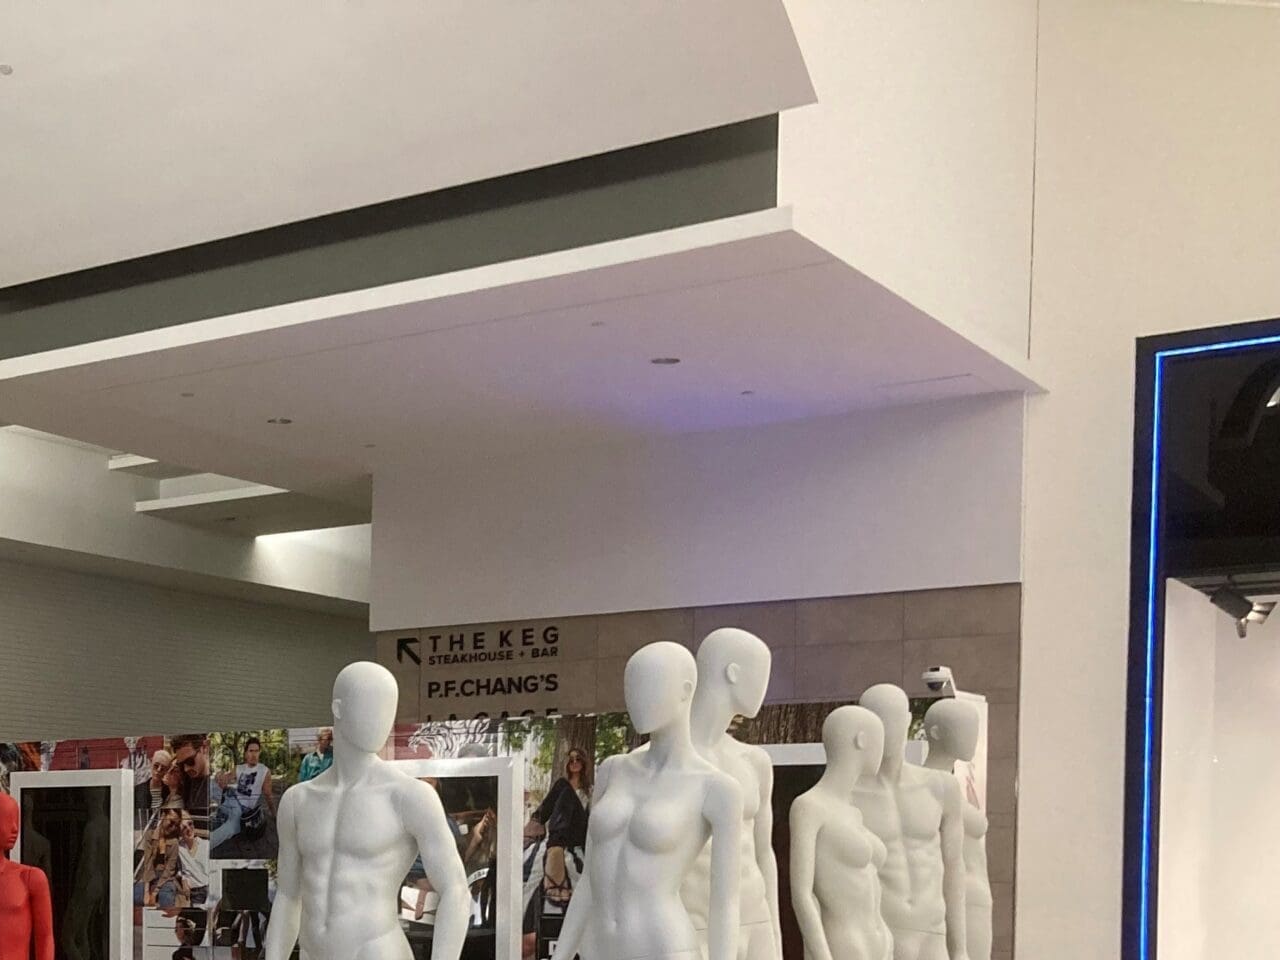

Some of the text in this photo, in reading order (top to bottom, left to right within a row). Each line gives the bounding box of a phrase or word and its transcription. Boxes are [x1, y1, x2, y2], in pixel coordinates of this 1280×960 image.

[428, 626, 559, 652] THE KEG
[428, 650, 514, 666] STEAKHOUSE
[531, 646, 558, 658] BAR
[427, 673, 559, 698] P.F.CHANG'S
